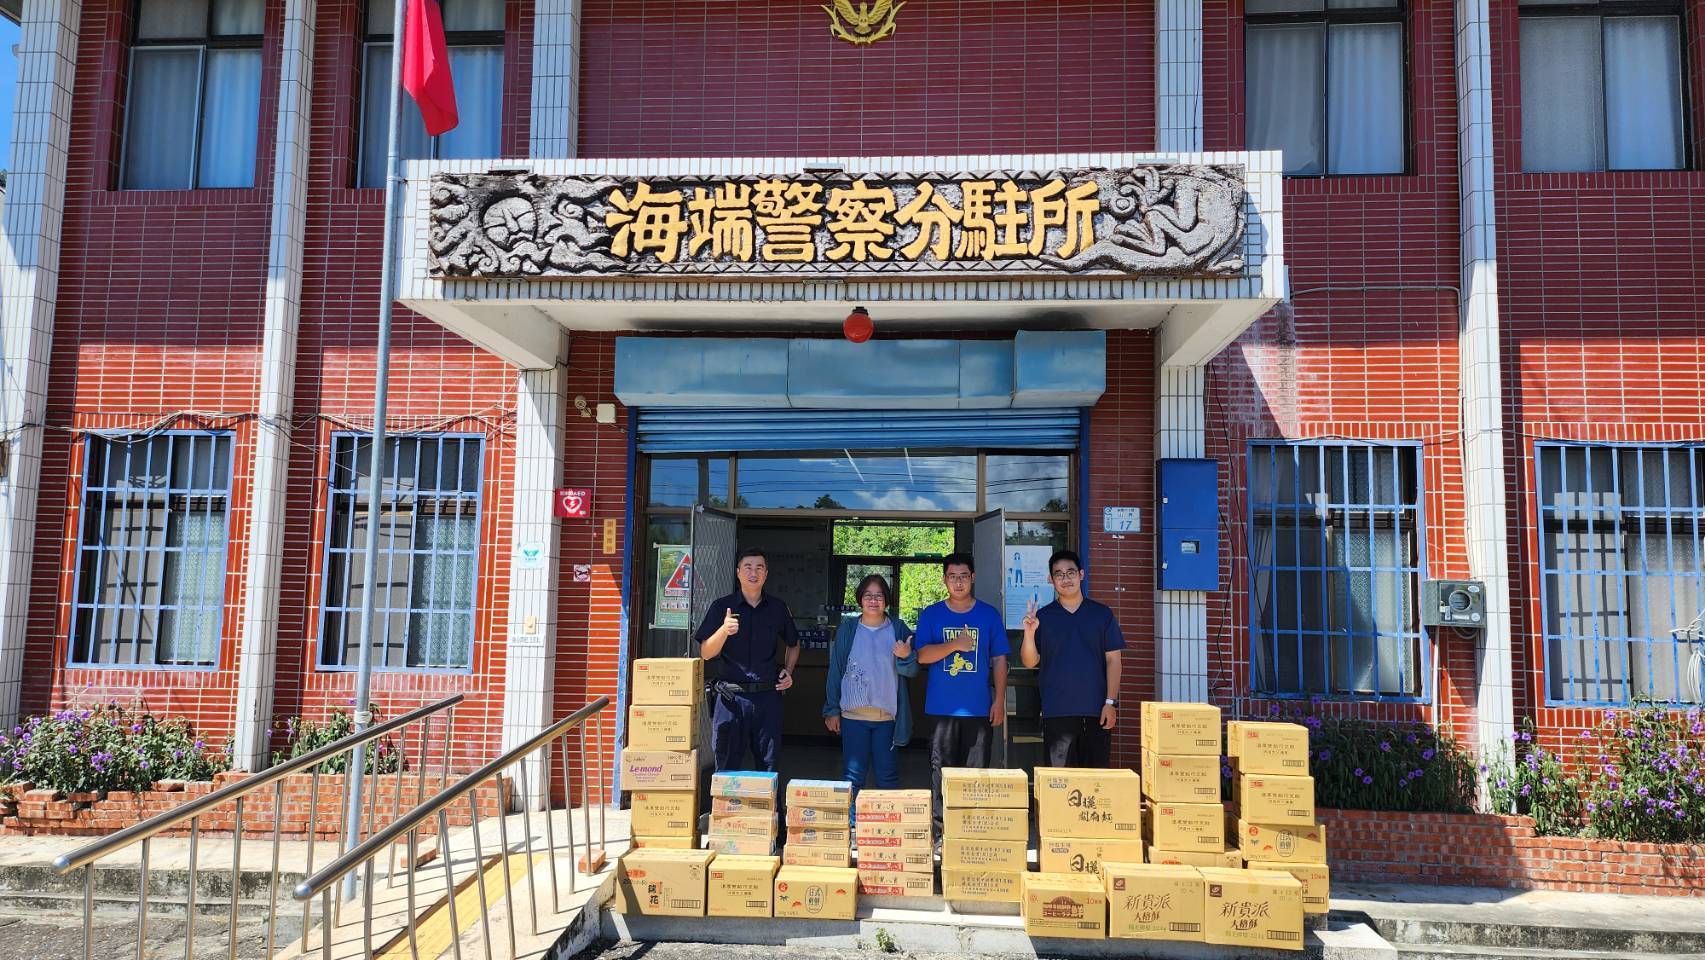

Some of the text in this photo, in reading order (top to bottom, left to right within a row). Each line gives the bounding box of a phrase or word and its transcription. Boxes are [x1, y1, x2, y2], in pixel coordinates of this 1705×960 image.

[606, 179, 1100, 263] 海端警察分駐所
[1120, 520, 1132, 530] 17
[1123, 893, 1173, 911] 新貴派
[1219, 901, 1271, 919] 新貴派
